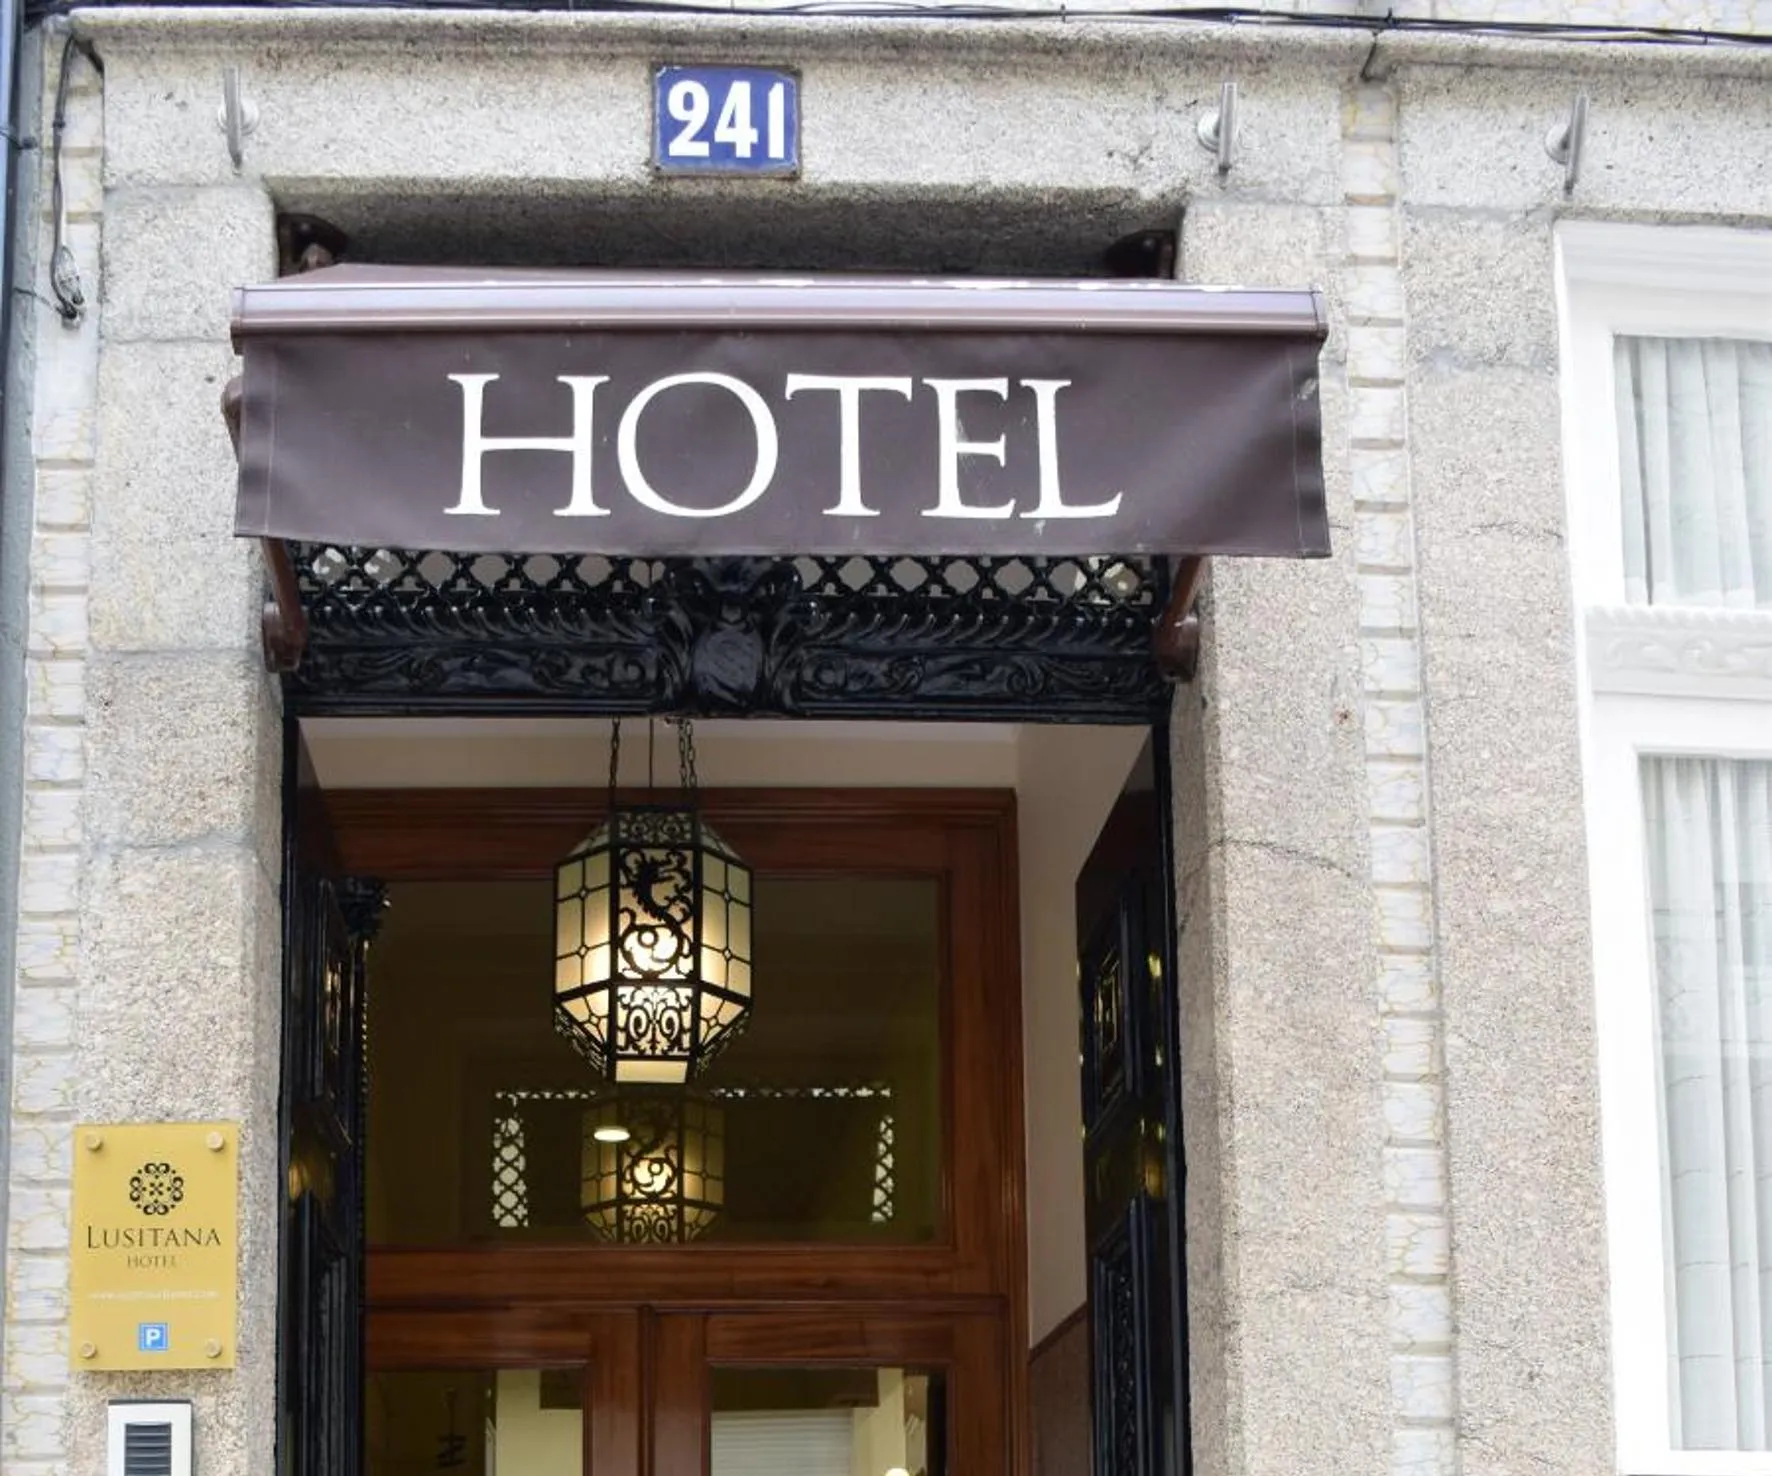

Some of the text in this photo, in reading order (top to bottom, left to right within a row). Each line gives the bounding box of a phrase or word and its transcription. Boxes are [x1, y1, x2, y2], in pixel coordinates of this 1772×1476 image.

[667, 80, 785, 159] 241
[443, 372, 1123, 519] HOTEL
[87, 1225, 222, 1249] LUSITANA
[127, 1254, 178, 1269] HOTEL
[145, 1327, 161, 1346] P
